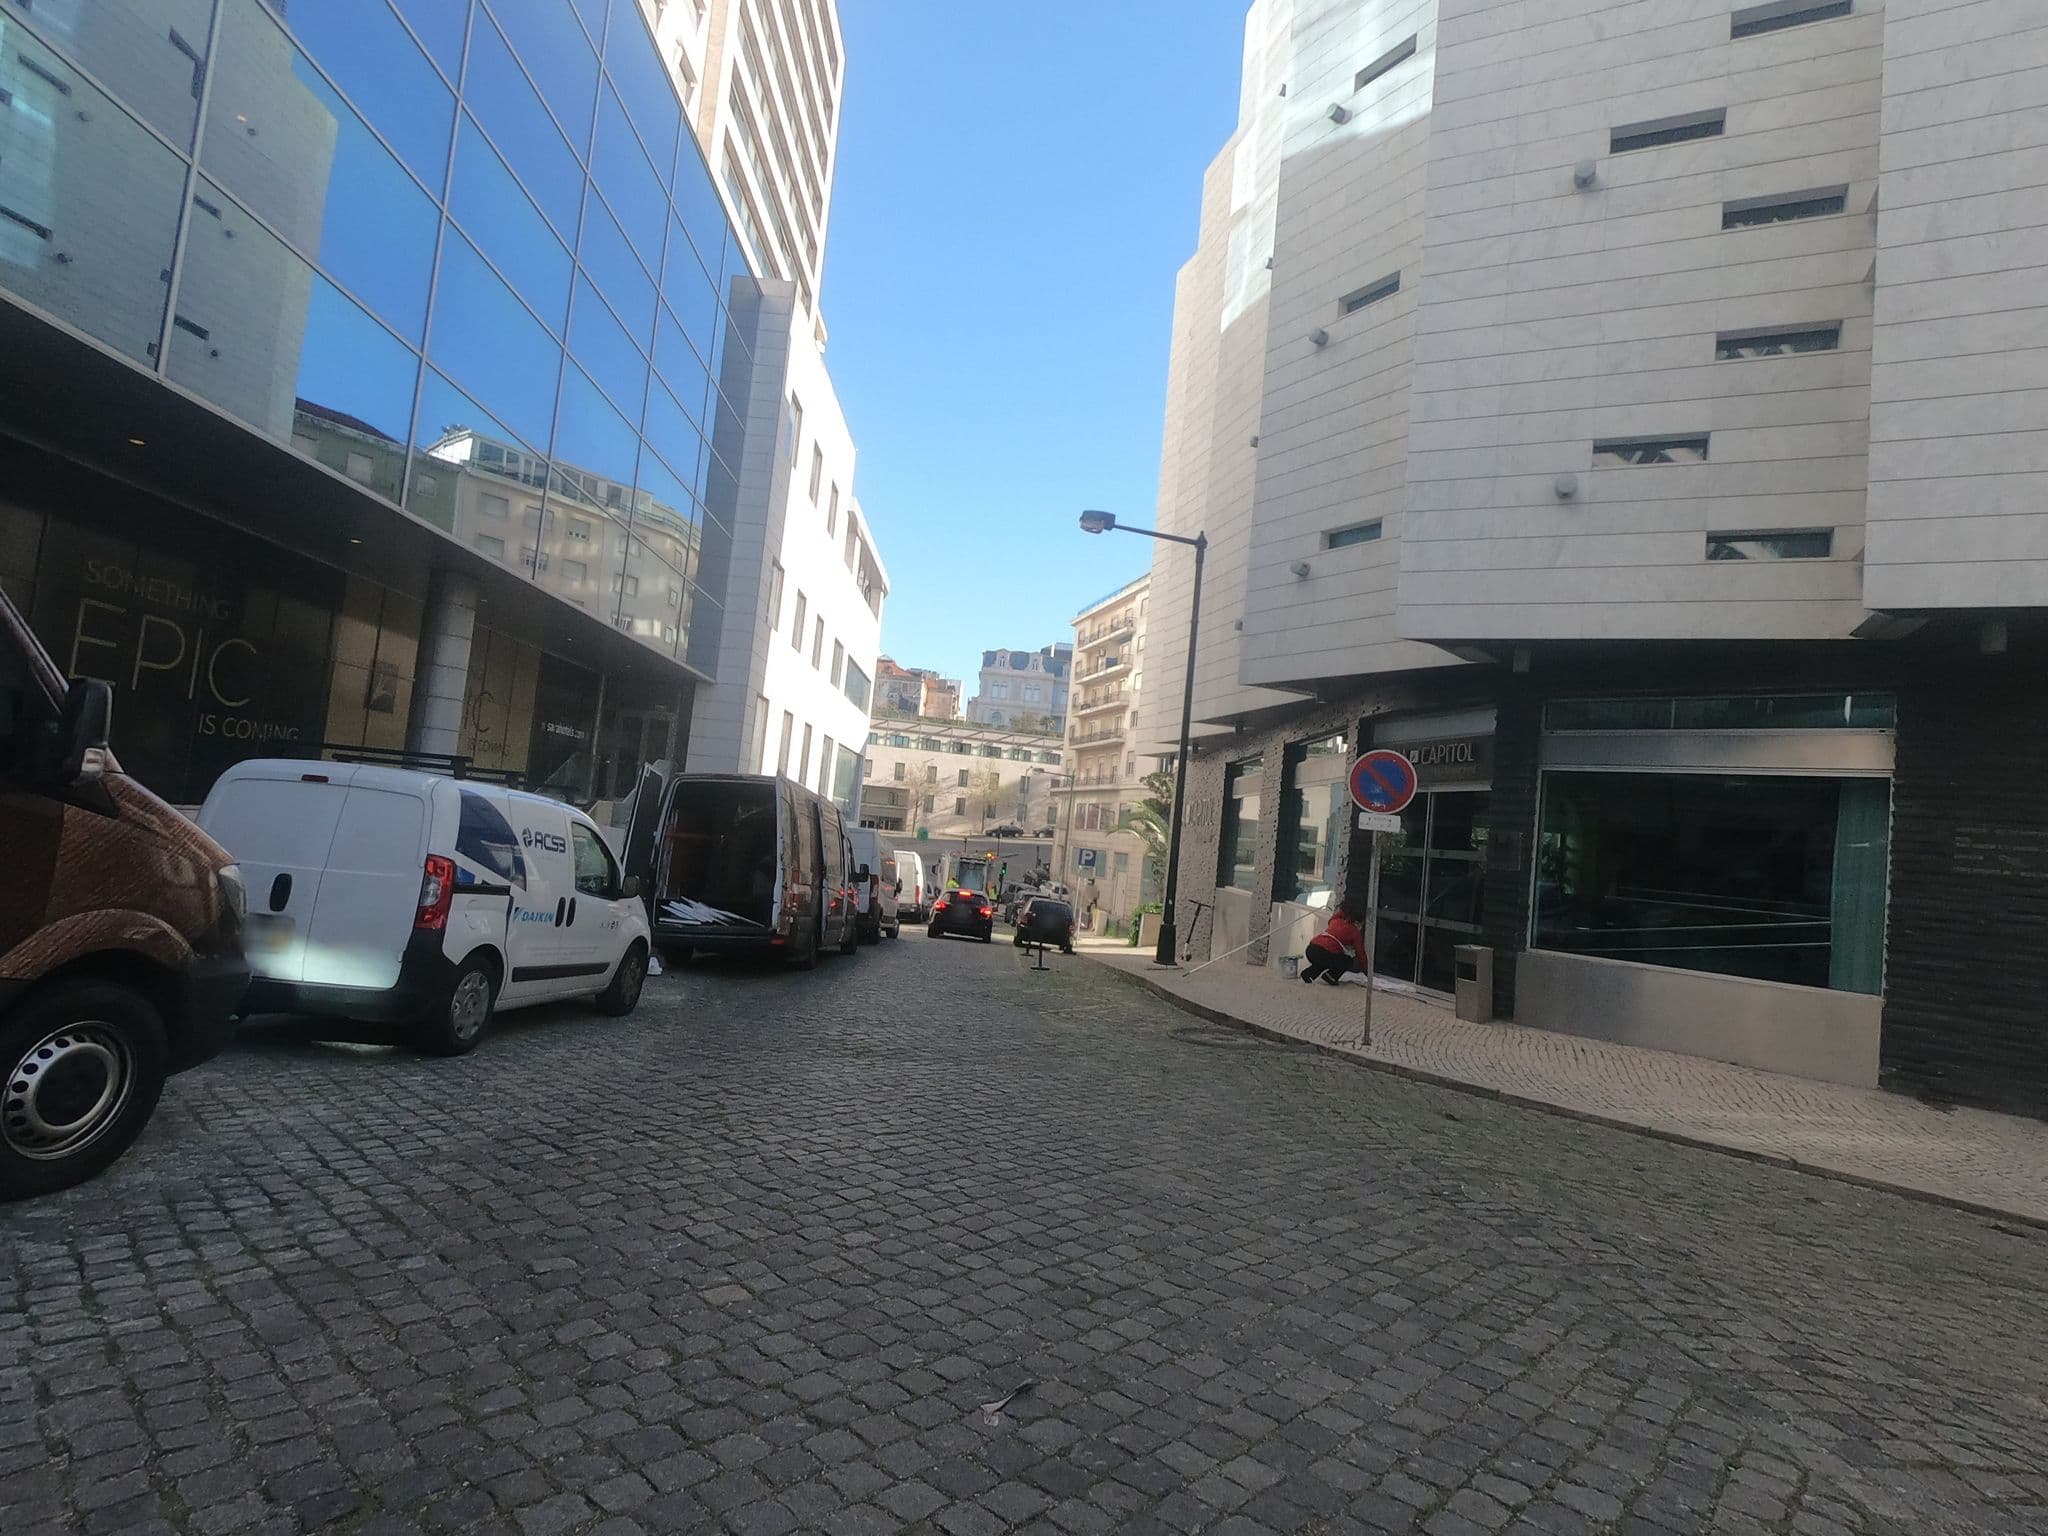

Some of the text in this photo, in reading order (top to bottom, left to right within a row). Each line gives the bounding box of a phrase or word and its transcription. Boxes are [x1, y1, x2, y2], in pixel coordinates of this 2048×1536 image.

[86, 558, 232, 620] SOMETHING
[68, 596, 257, 707] EPIC
[198, 712, 302, 741] IS COMING
[1421, 743, 1475, 765] CAPITOL
[1081, 850, 1094, 865] P
[521, 911, 555, 922] DAIKIN
